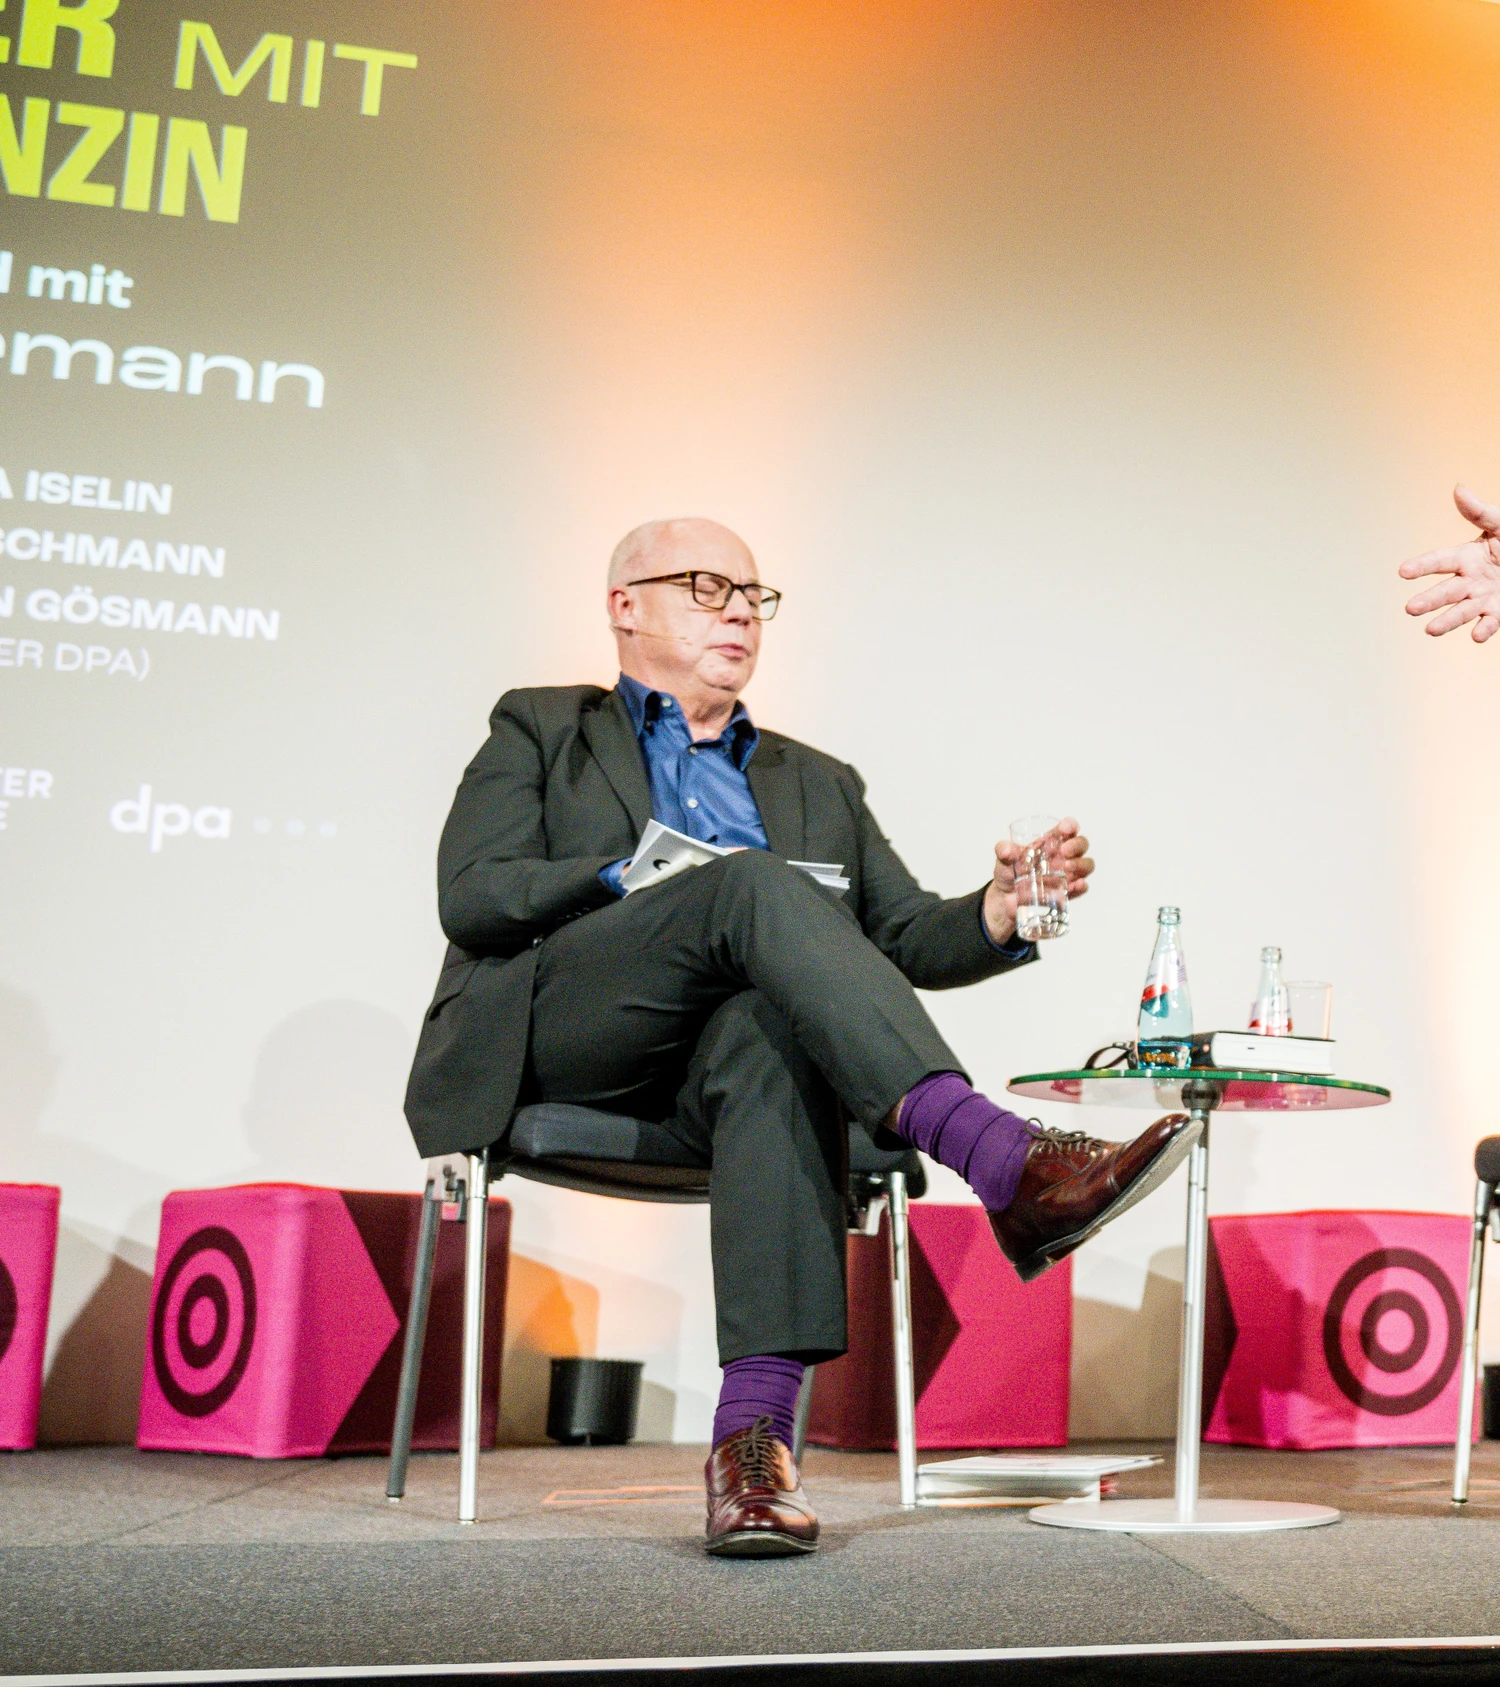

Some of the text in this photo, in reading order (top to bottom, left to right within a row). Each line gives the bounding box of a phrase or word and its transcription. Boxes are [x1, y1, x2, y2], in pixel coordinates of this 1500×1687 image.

[173, 20, 418, 117] MIT
[26, 263, 134, 309] mit
[0, 331, 325, 408] mann
[24, 469, 173, 515] ISELIN
[0, 527, 226, 578] CHMANN
[25, 584, 280, 641] GÖSMANN
[54, 641, 150, 682] DPA)
[0, 767, 53, 799] ER
[109, 784, 232, 853] dpa
